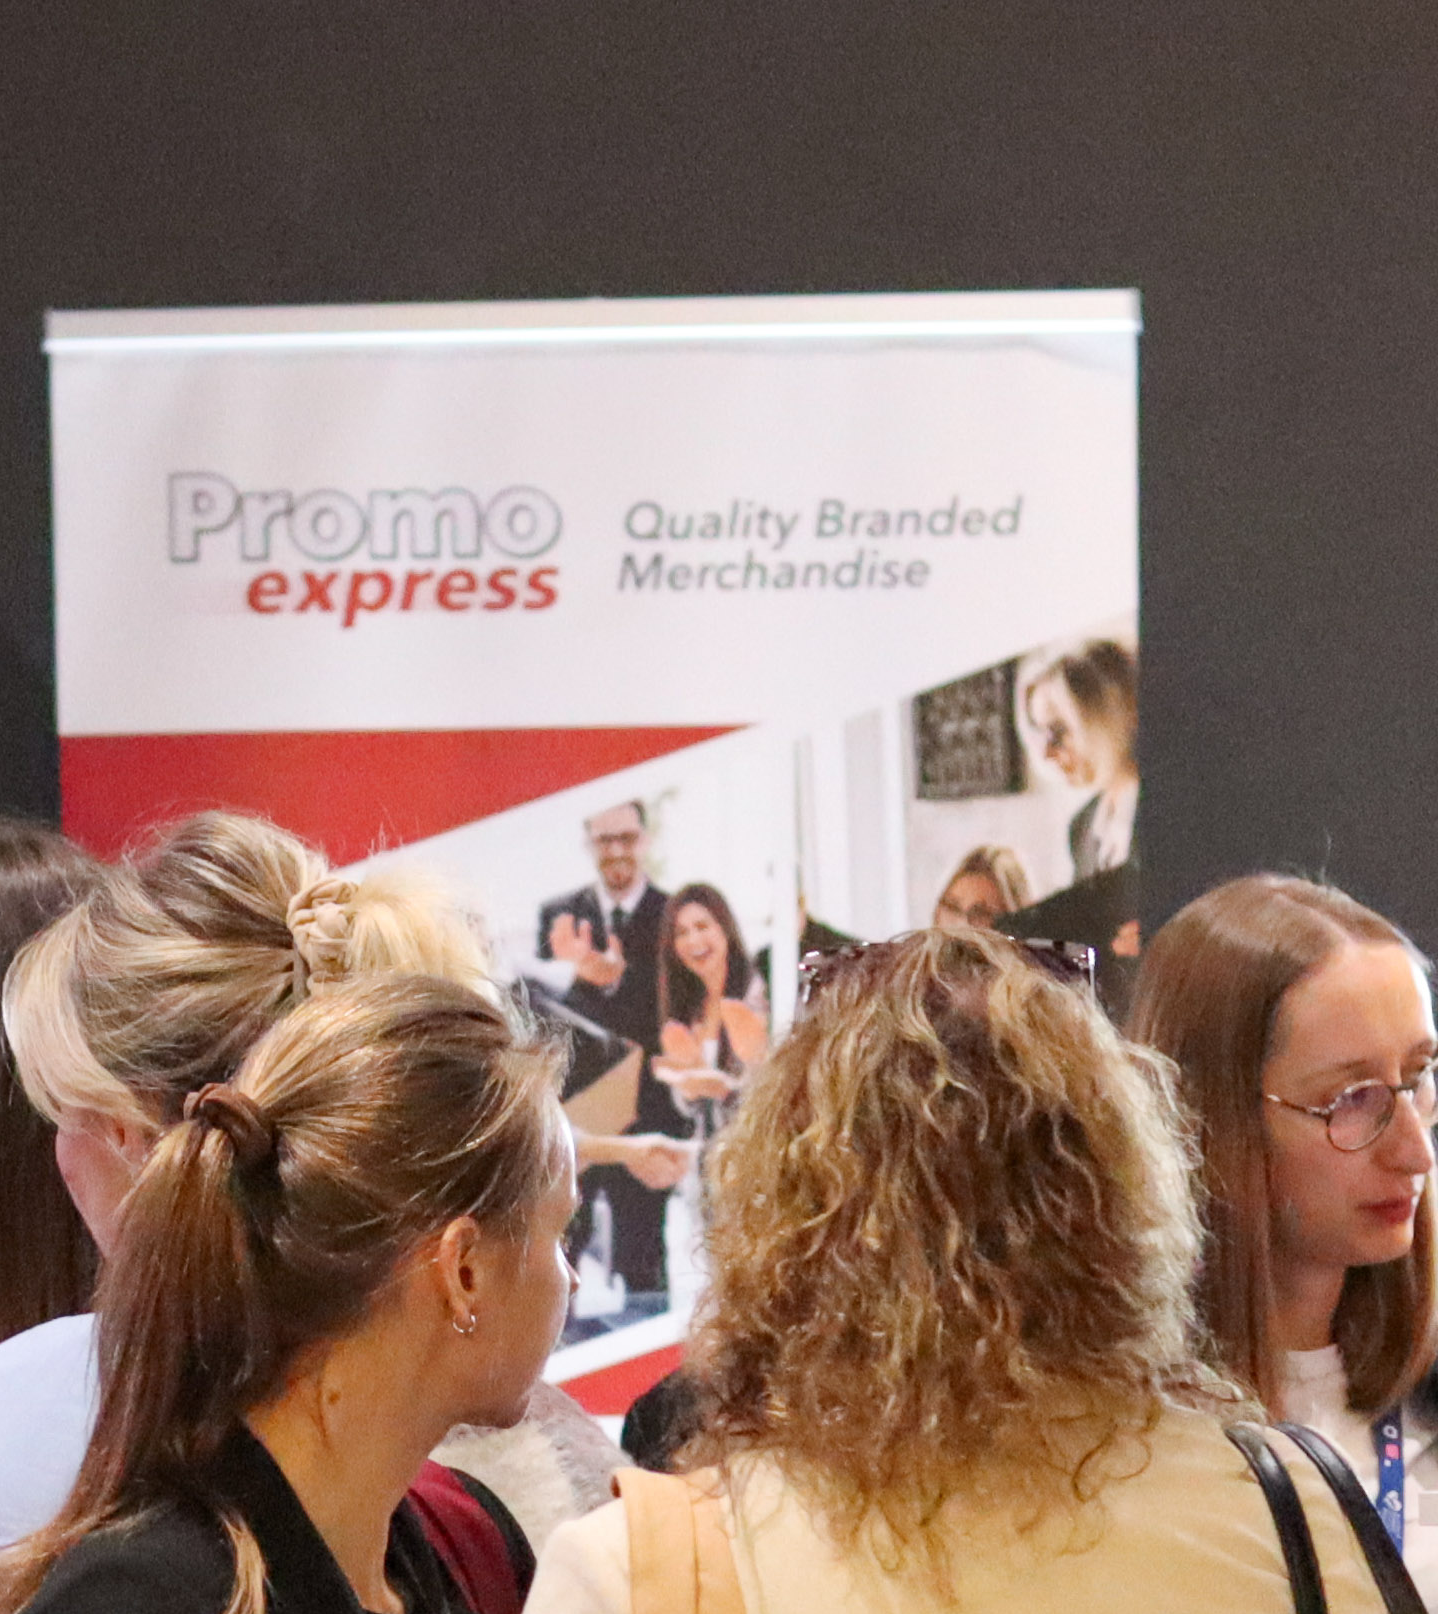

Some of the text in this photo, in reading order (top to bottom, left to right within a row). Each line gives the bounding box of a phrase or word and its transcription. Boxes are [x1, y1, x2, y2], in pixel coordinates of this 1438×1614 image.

[167, 470, 563, 563] Promo
[624, 495, 1021, 550] Quality Branded
[245, 566, 558, 629] express
[617, 549, 930, 591] Merchandise
